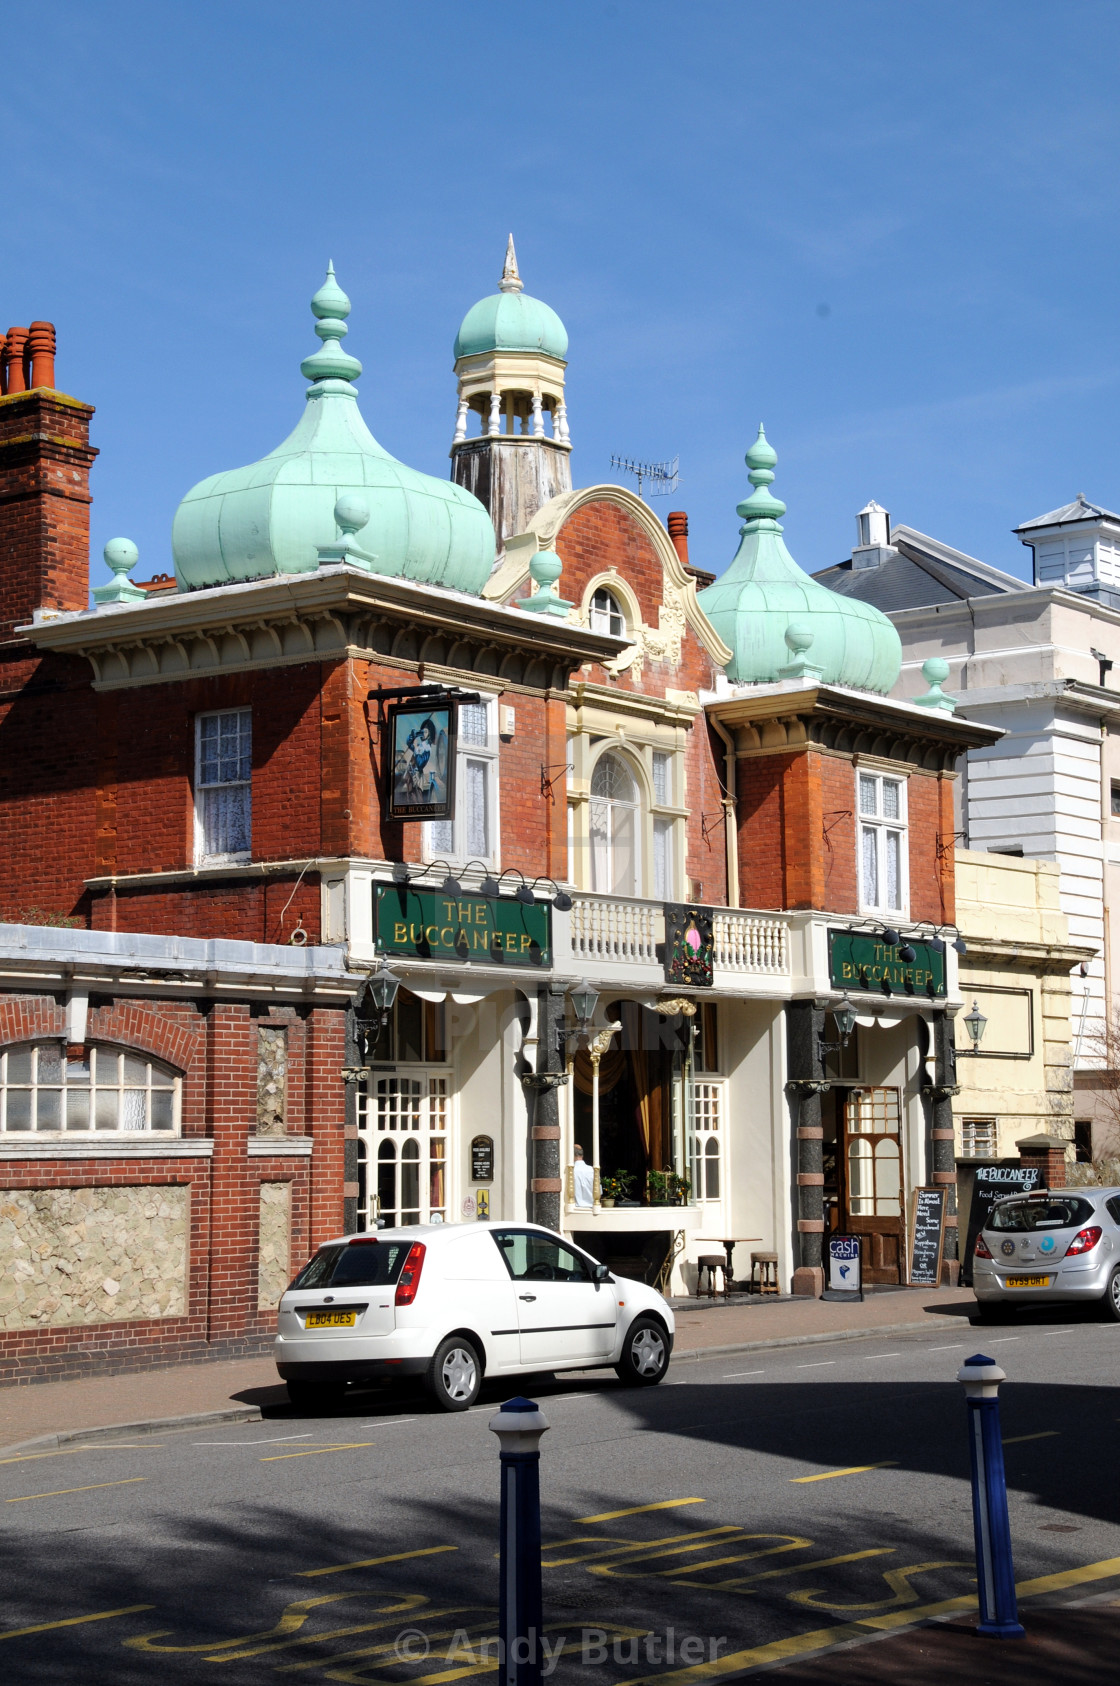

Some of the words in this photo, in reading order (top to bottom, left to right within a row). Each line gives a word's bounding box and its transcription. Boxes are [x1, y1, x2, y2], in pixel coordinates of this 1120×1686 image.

[394, 806, 407, 814] THE
[408, 803, 446, 814] BUCCANEER
[442, 901, 488, 925] THE
[393, 922, 532, 953] BUCCANEER
[873, 944, 904, 963] THE
[841, 961, 933, 986] BUCCANEER
[976, 1168, 990, 1180] THE
[988, 1167, 1039, 1183] BUCCANEER
[979, 1190, 993, 1199] Food
[829, 1239, 859, 1254] cash
[1009, 1276, 1029, 1286] GY59
[309, 1313, 332, 1326] LB04
[333, 1312, 352, 1324] UES
